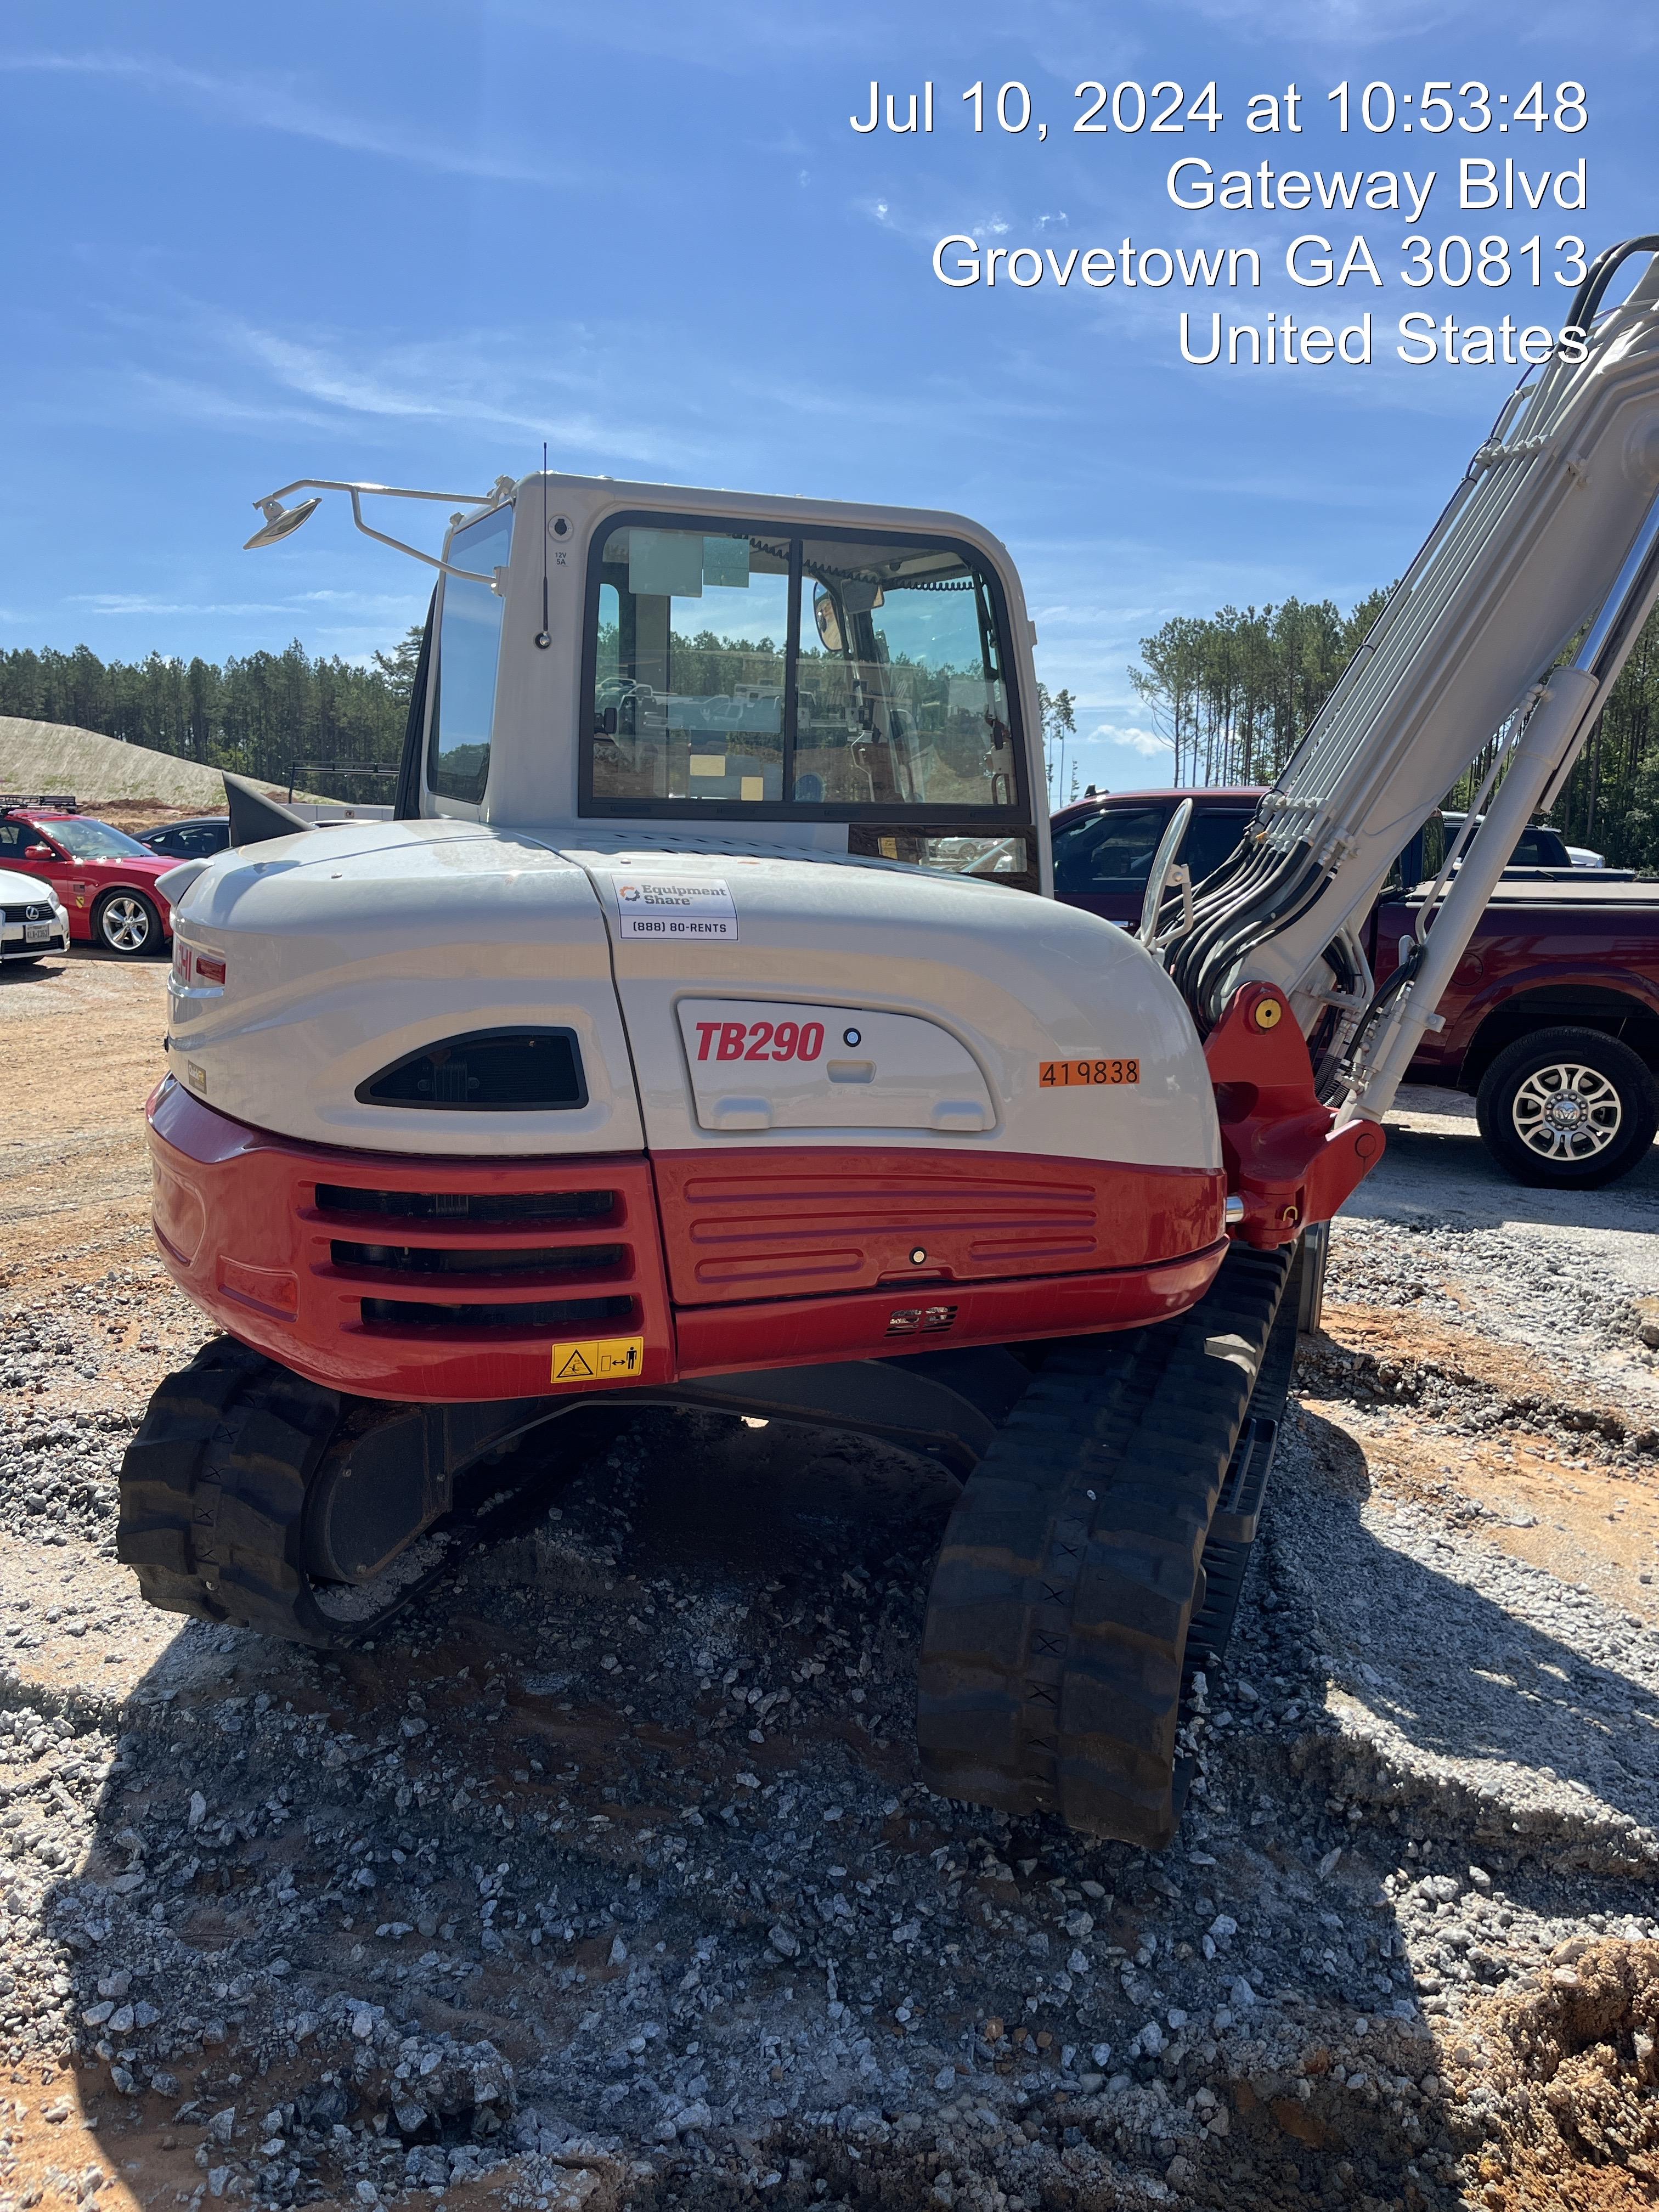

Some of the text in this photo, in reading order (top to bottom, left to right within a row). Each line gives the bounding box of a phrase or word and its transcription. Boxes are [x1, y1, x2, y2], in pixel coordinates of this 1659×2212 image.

[641, 884, 727, 896] Equipment
[644, 895, 691, 905] Share
[633, 921, 727, 933] (888) 80-RENTS
[695, 1022, 825, 1062] TB290
[1042, 1060, 1138, 1085] 419838
